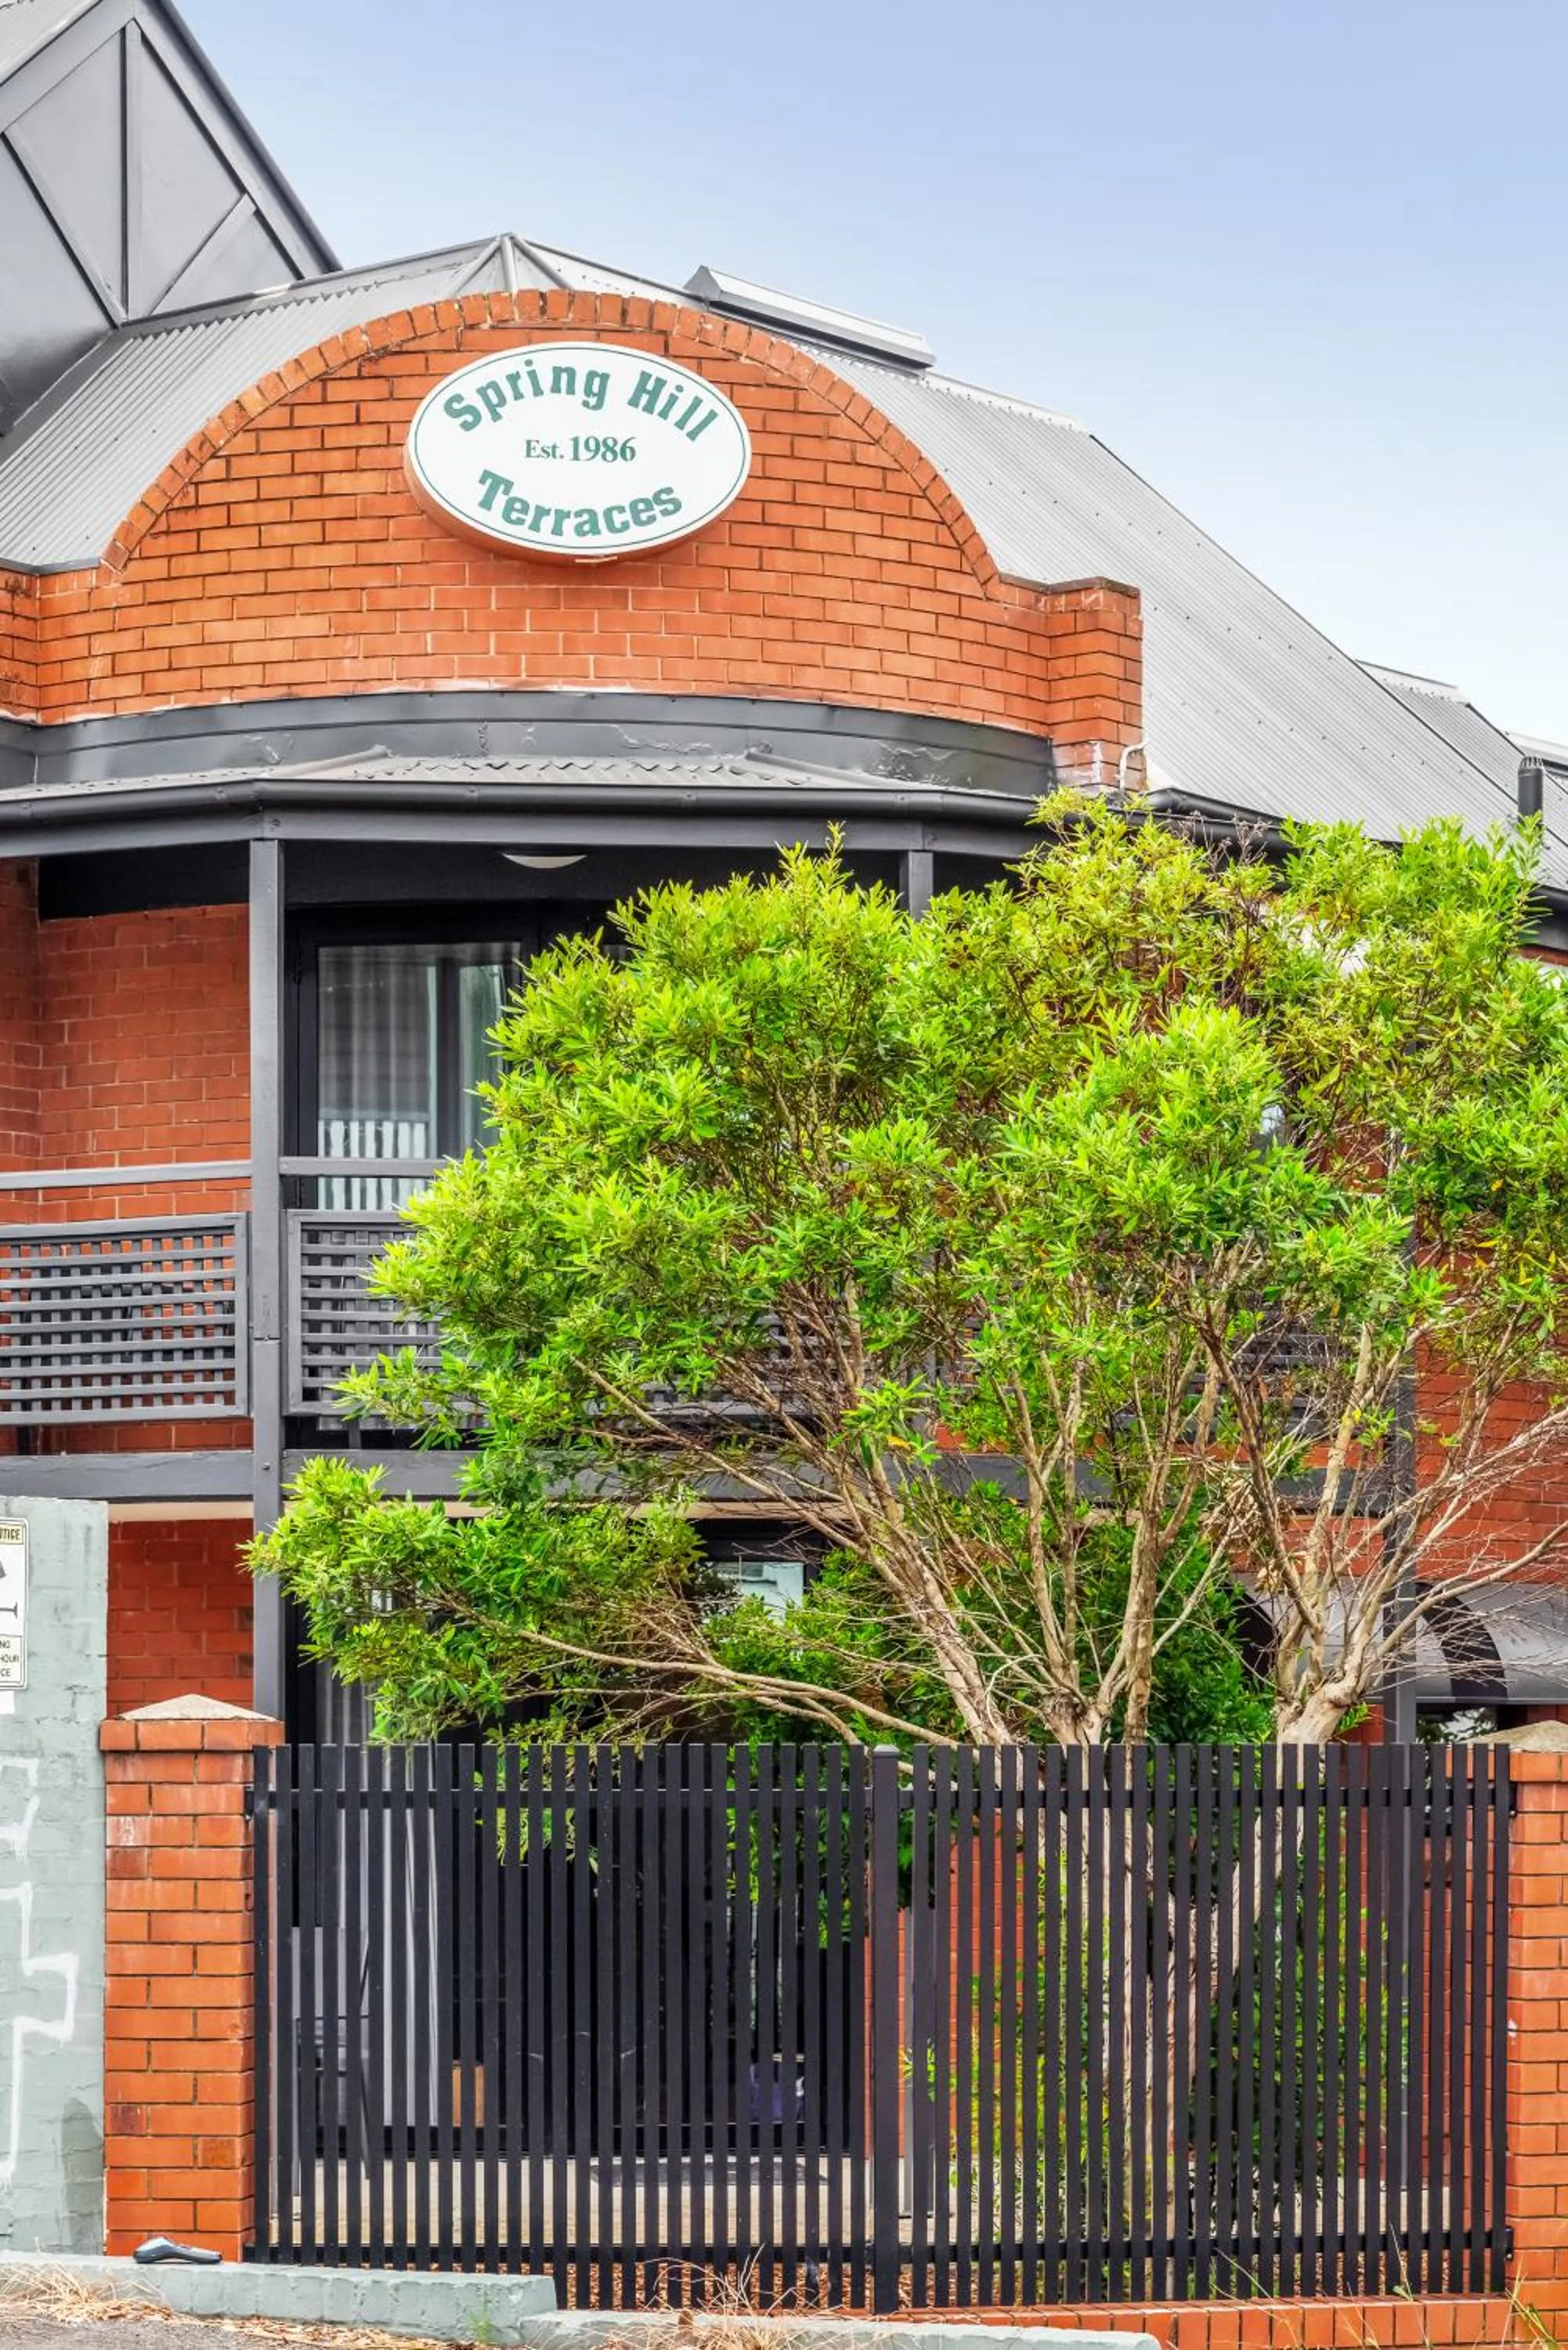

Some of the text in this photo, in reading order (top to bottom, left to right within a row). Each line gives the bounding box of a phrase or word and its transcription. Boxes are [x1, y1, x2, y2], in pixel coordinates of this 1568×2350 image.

[443, 359, 719, 443] Spring Hill
[478, 468, 683, 538] Terraces
